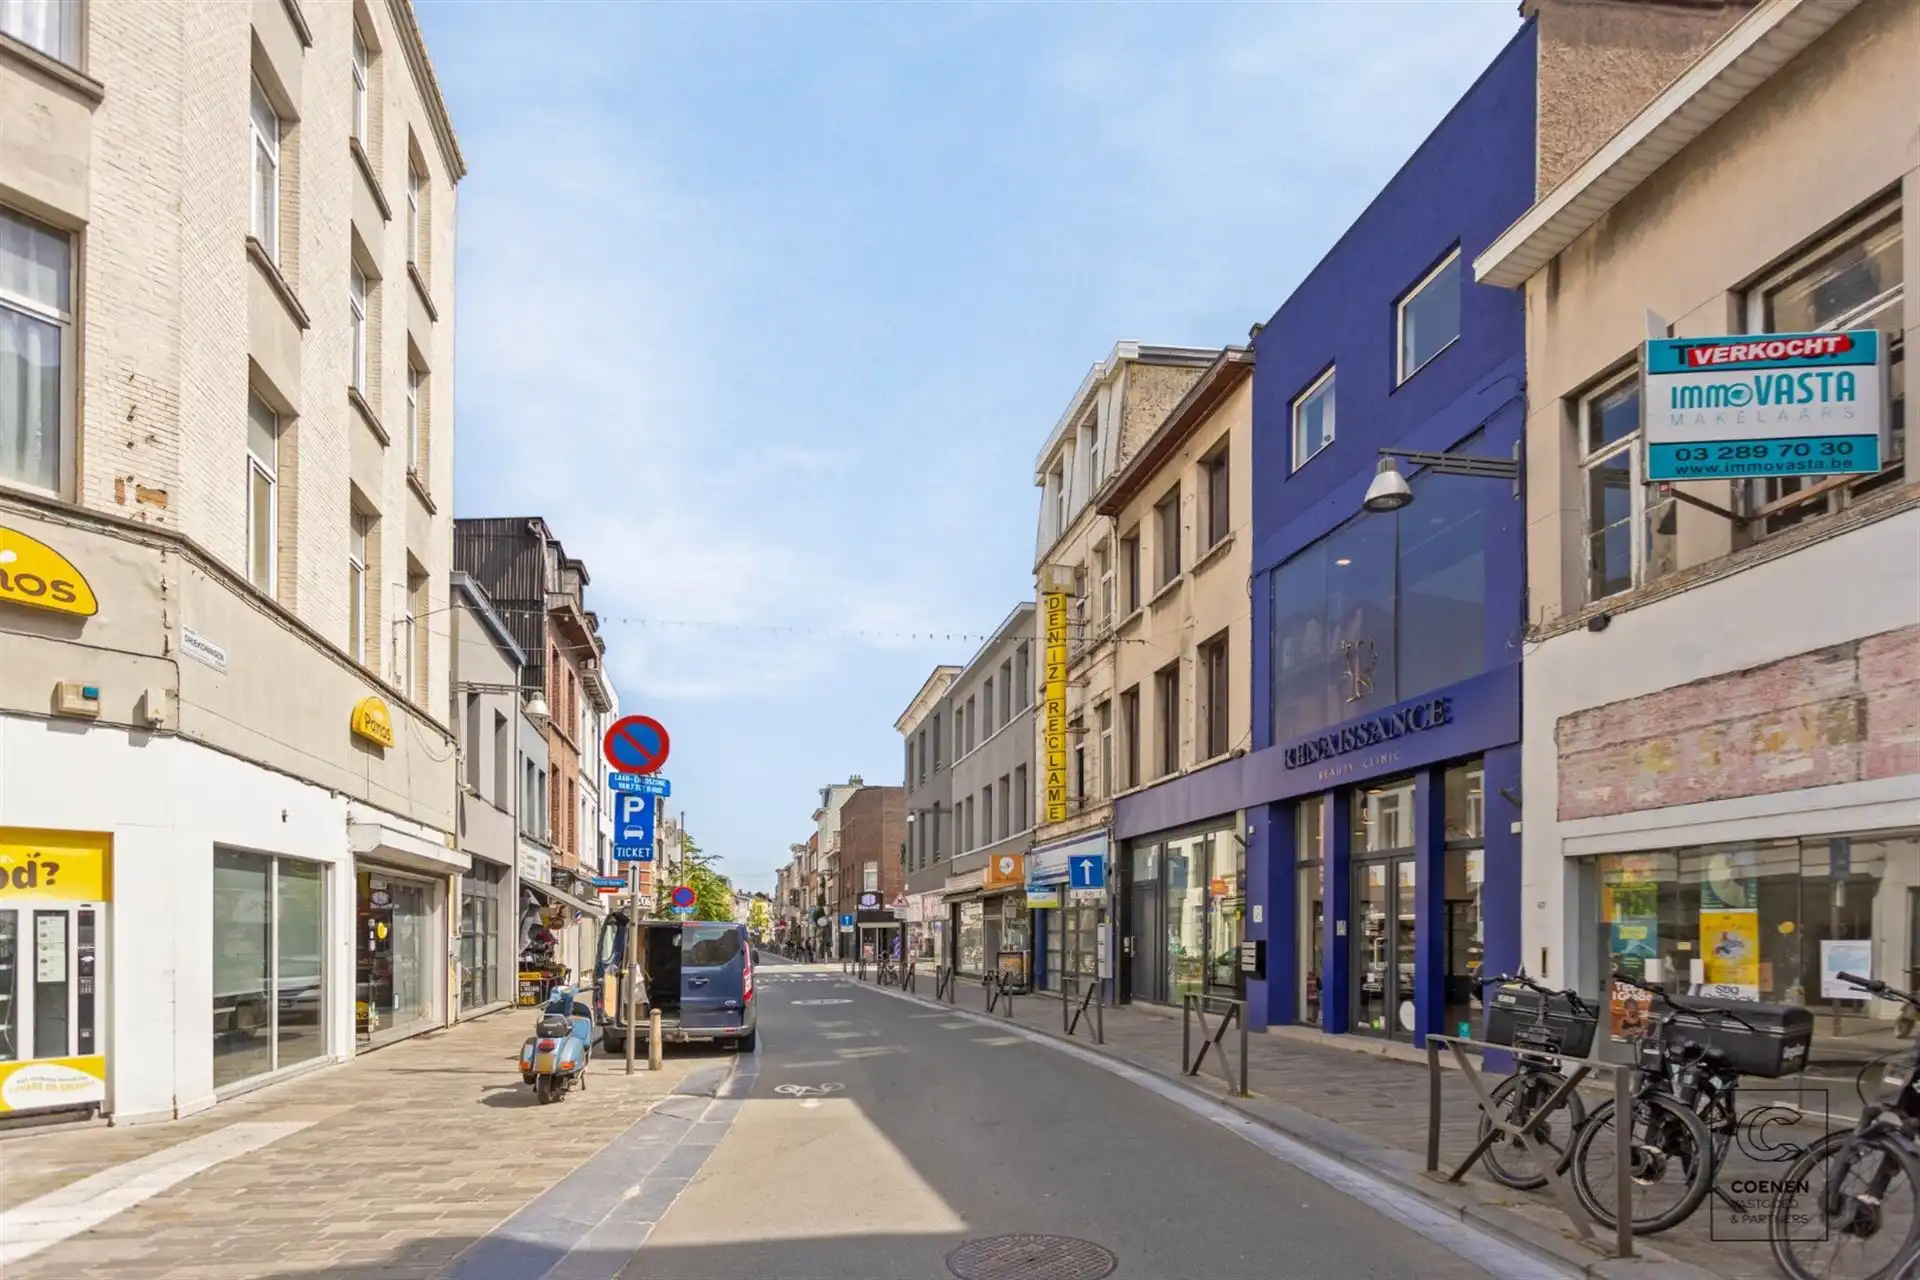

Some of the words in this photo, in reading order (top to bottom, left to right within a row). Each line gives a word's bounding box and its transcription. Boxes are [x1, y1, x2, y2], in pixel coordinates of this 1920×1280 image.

[1695, 336, 1841, 365] VERKOCHT
[1671, 406, 1855, 426] MAKELAARS
[1675, 448, 1708, 461] 03
[1718, 445, 1768, 460] 289
[1778, 443, 1810, 457] 70
[1820, 441, 1853, 455] 30
[1675, 458, 1853, 475] www.immovasta.be
[1049, 596, 1060, 680] DENIZ
[364, 712, 391, 741] Panos
[1048, 701, 1060, 820] RECLAME
[1318, 764, 1353, 781] BEAUTY
[1363, 752, 1400, 768] CLINIC
[623, 796, 645, 823] P
[616, 847, 651, 857] TICKET
